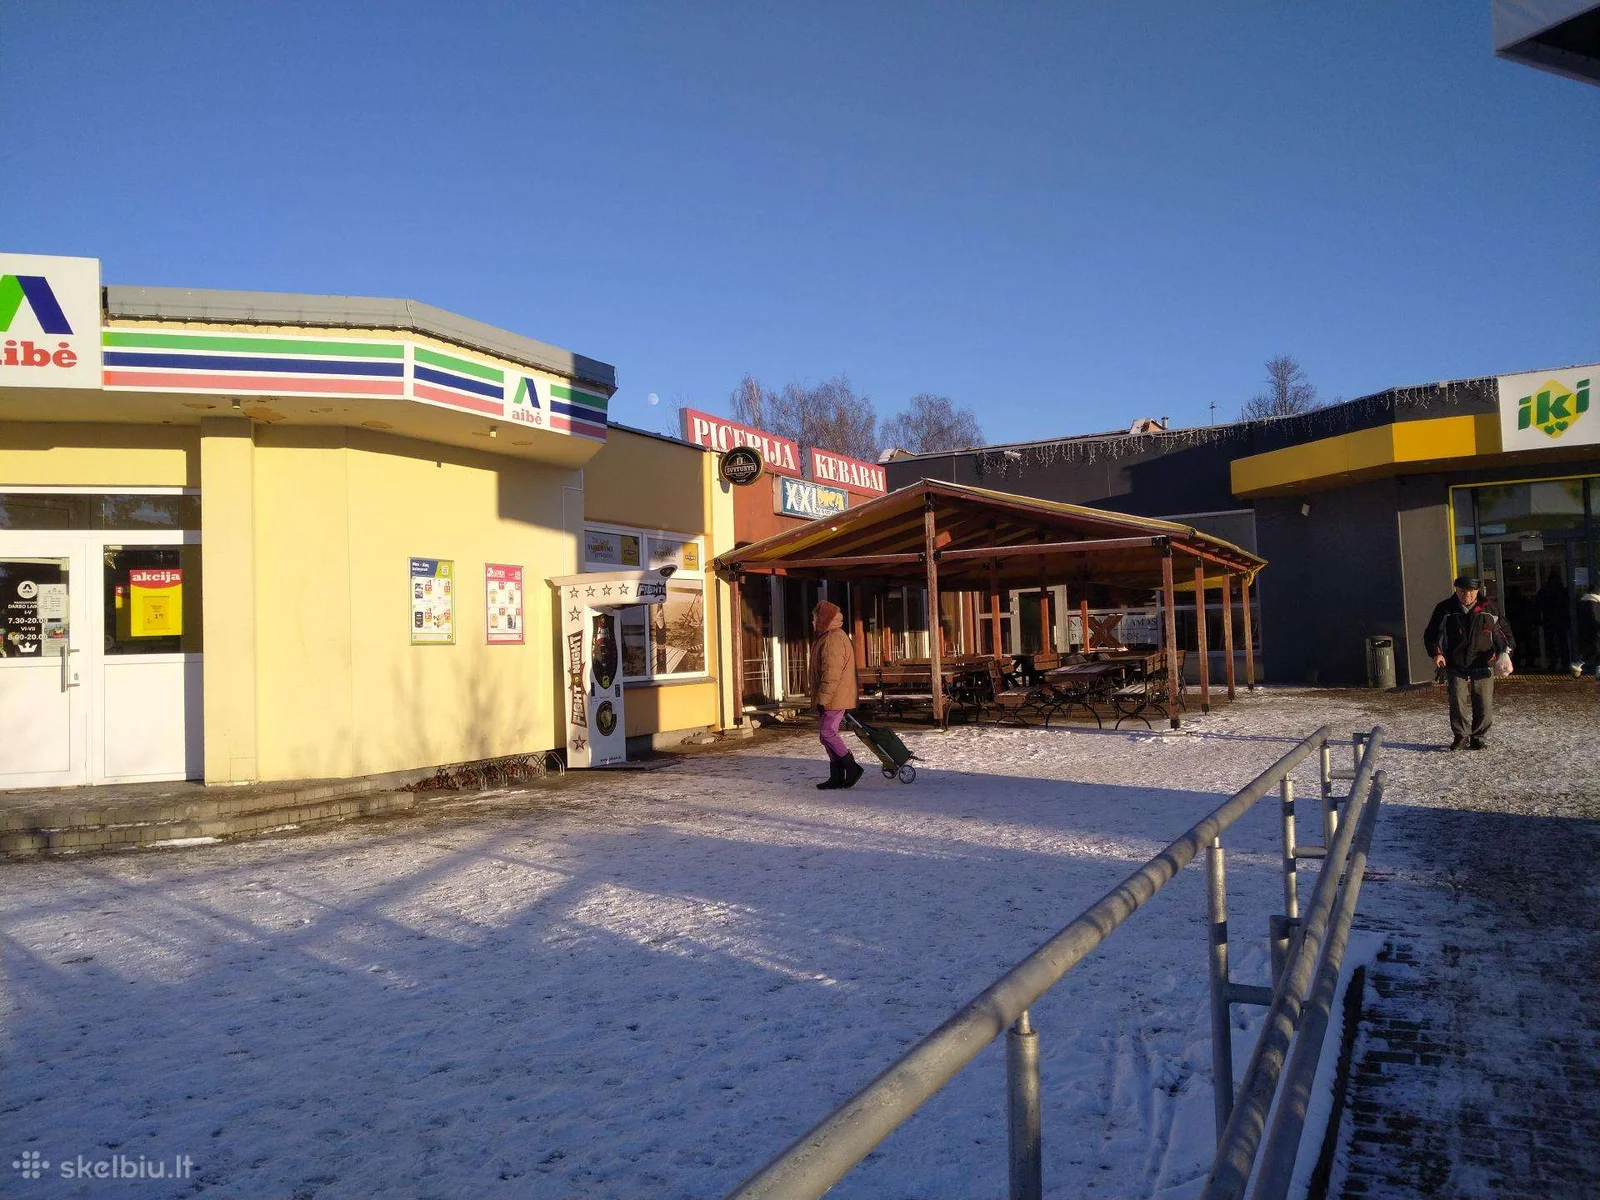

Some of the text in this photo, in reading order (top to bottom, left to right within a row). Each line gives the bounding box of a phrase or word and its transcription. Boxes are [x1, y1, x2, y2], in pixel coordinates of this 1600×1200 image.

[0, 340, 77, 368] ibė
[511, 408, 542, 426] aibė
[1518, 378, 1590, 431] iki
[814, 453, 884, 492] KEBABAI
[132, 571, 181, 583] akcija
[569, 634, 582, 674] NIGHT
